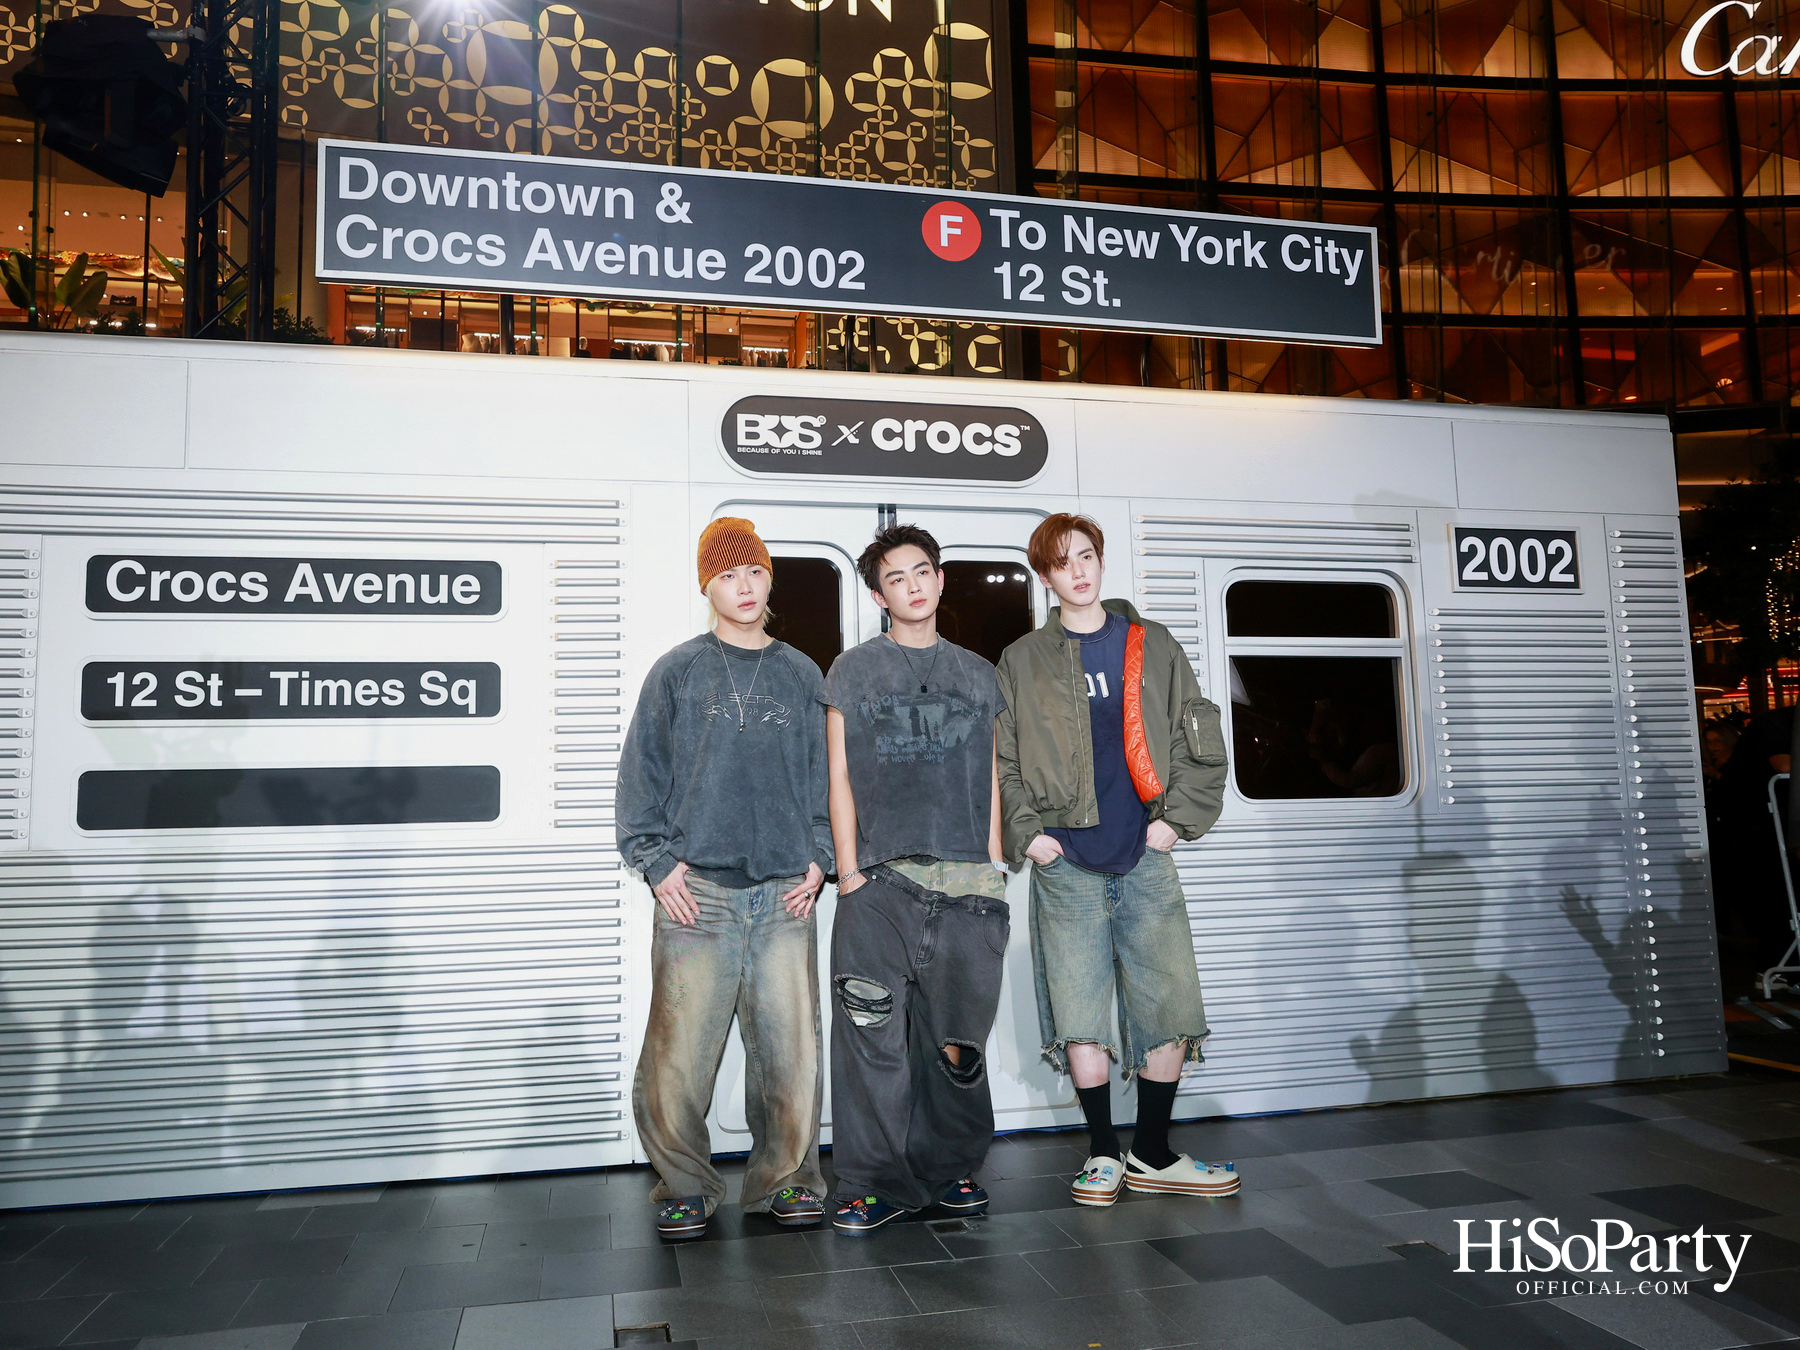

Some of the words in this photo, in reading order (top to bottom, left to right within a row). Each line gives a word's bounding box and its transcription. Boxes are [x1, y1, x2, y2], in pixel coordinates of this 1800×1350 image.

[338, 156, 634, 220] Downtown
[655, 181, 693, 224] &
[336, 213, 507, 267] Crocs
[522, 227, 727, 281] Avenue
[743, 243, 866, 291] 2002
[939, 214, 963, 247] F
[989, 208, 1047, 251] To
[1063, 214, 1161, 260] New
[1167, 223, 1269, 269] York
[1280, 233, 1364, 286] City
[993, 261, 1045, 303] 12
[1061, 265, 1122, 308] St.
[736, 446, 770, 454] BECAUSE
[106, 559, 269, 603] Crocs
[283, 562, 481, 605] Avenue
[1459, 536, 1575, 583] 2002
[106, 671, 158, 707] 12
[174, 670, 224, 708] St
[269, 670, 405, 707] Times
[419, 670, 477, 715] Sq
